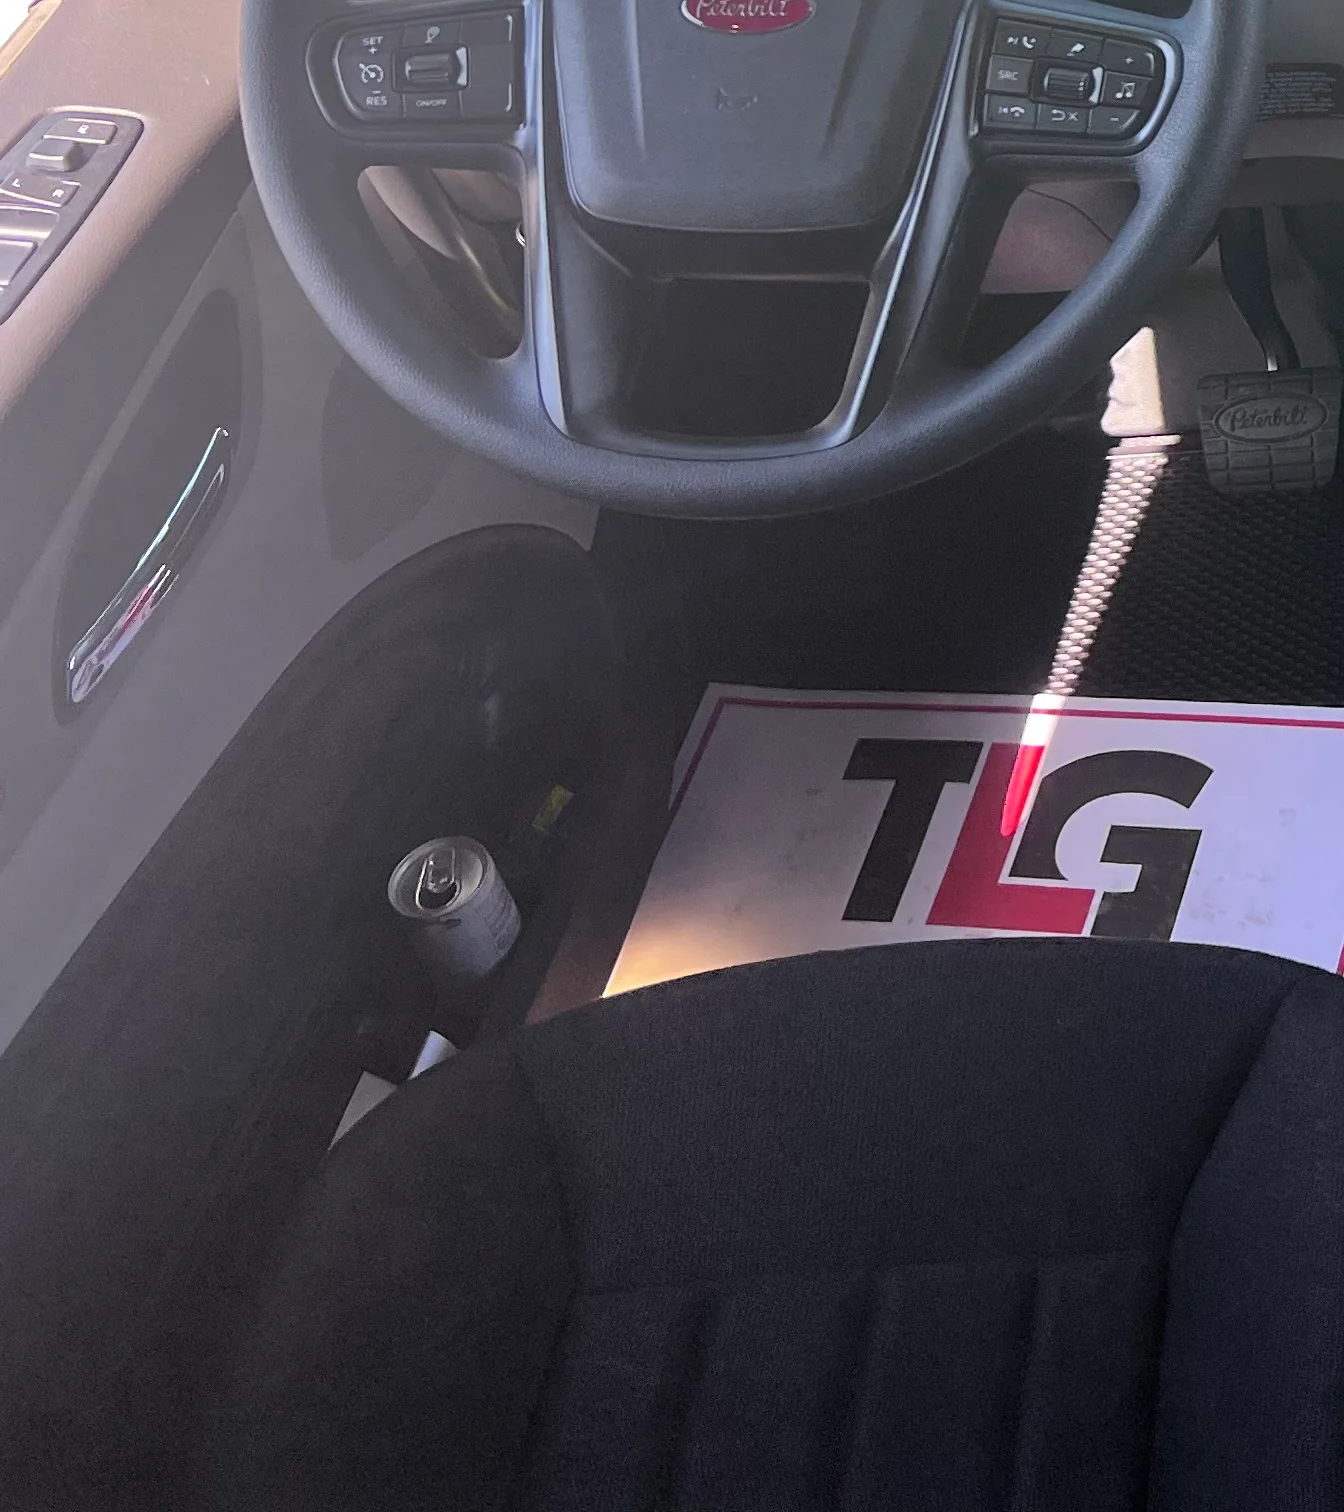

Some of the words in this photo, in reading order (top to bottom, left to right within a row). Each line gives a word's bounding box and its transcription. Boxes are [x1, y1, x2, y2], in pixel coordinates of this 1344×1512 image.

[362, 35, 384, 47] SET
[997, 69, 1020, 82] SRC
[365, 95, 388, 107] RES
[415, 98, 448, 108] ON/OFF
[1228, 405, 1309, 433] Peterbilt
[841, 737, 1215, 943] TLG
